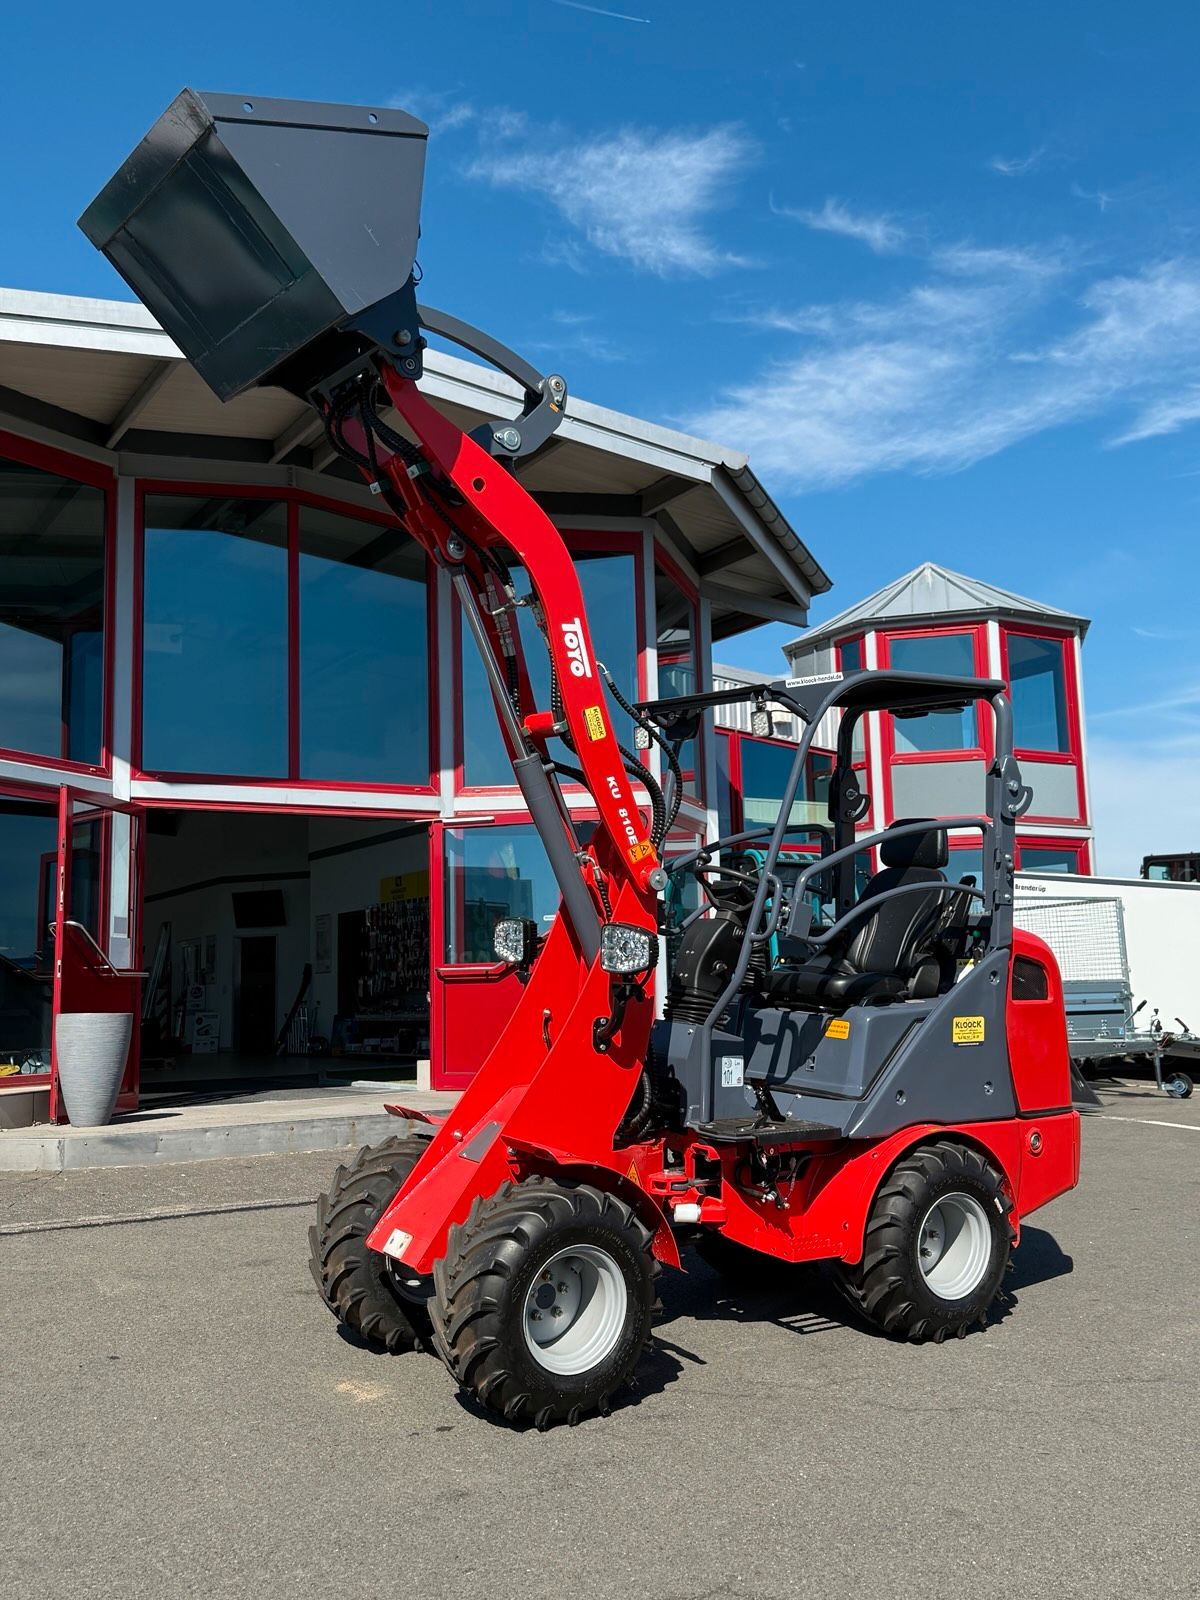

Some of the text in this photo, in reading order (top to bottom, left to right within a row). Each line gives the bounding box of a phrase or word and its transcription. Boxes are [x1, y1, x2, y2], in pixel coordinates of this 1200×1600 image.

[561, 617, 592, 678] TOYO
[593, 708, 605, 736] KLOOCK
[606, 775, 639, 846] KU 810E
[955, 1020, 982, 1029] KLOOCK
